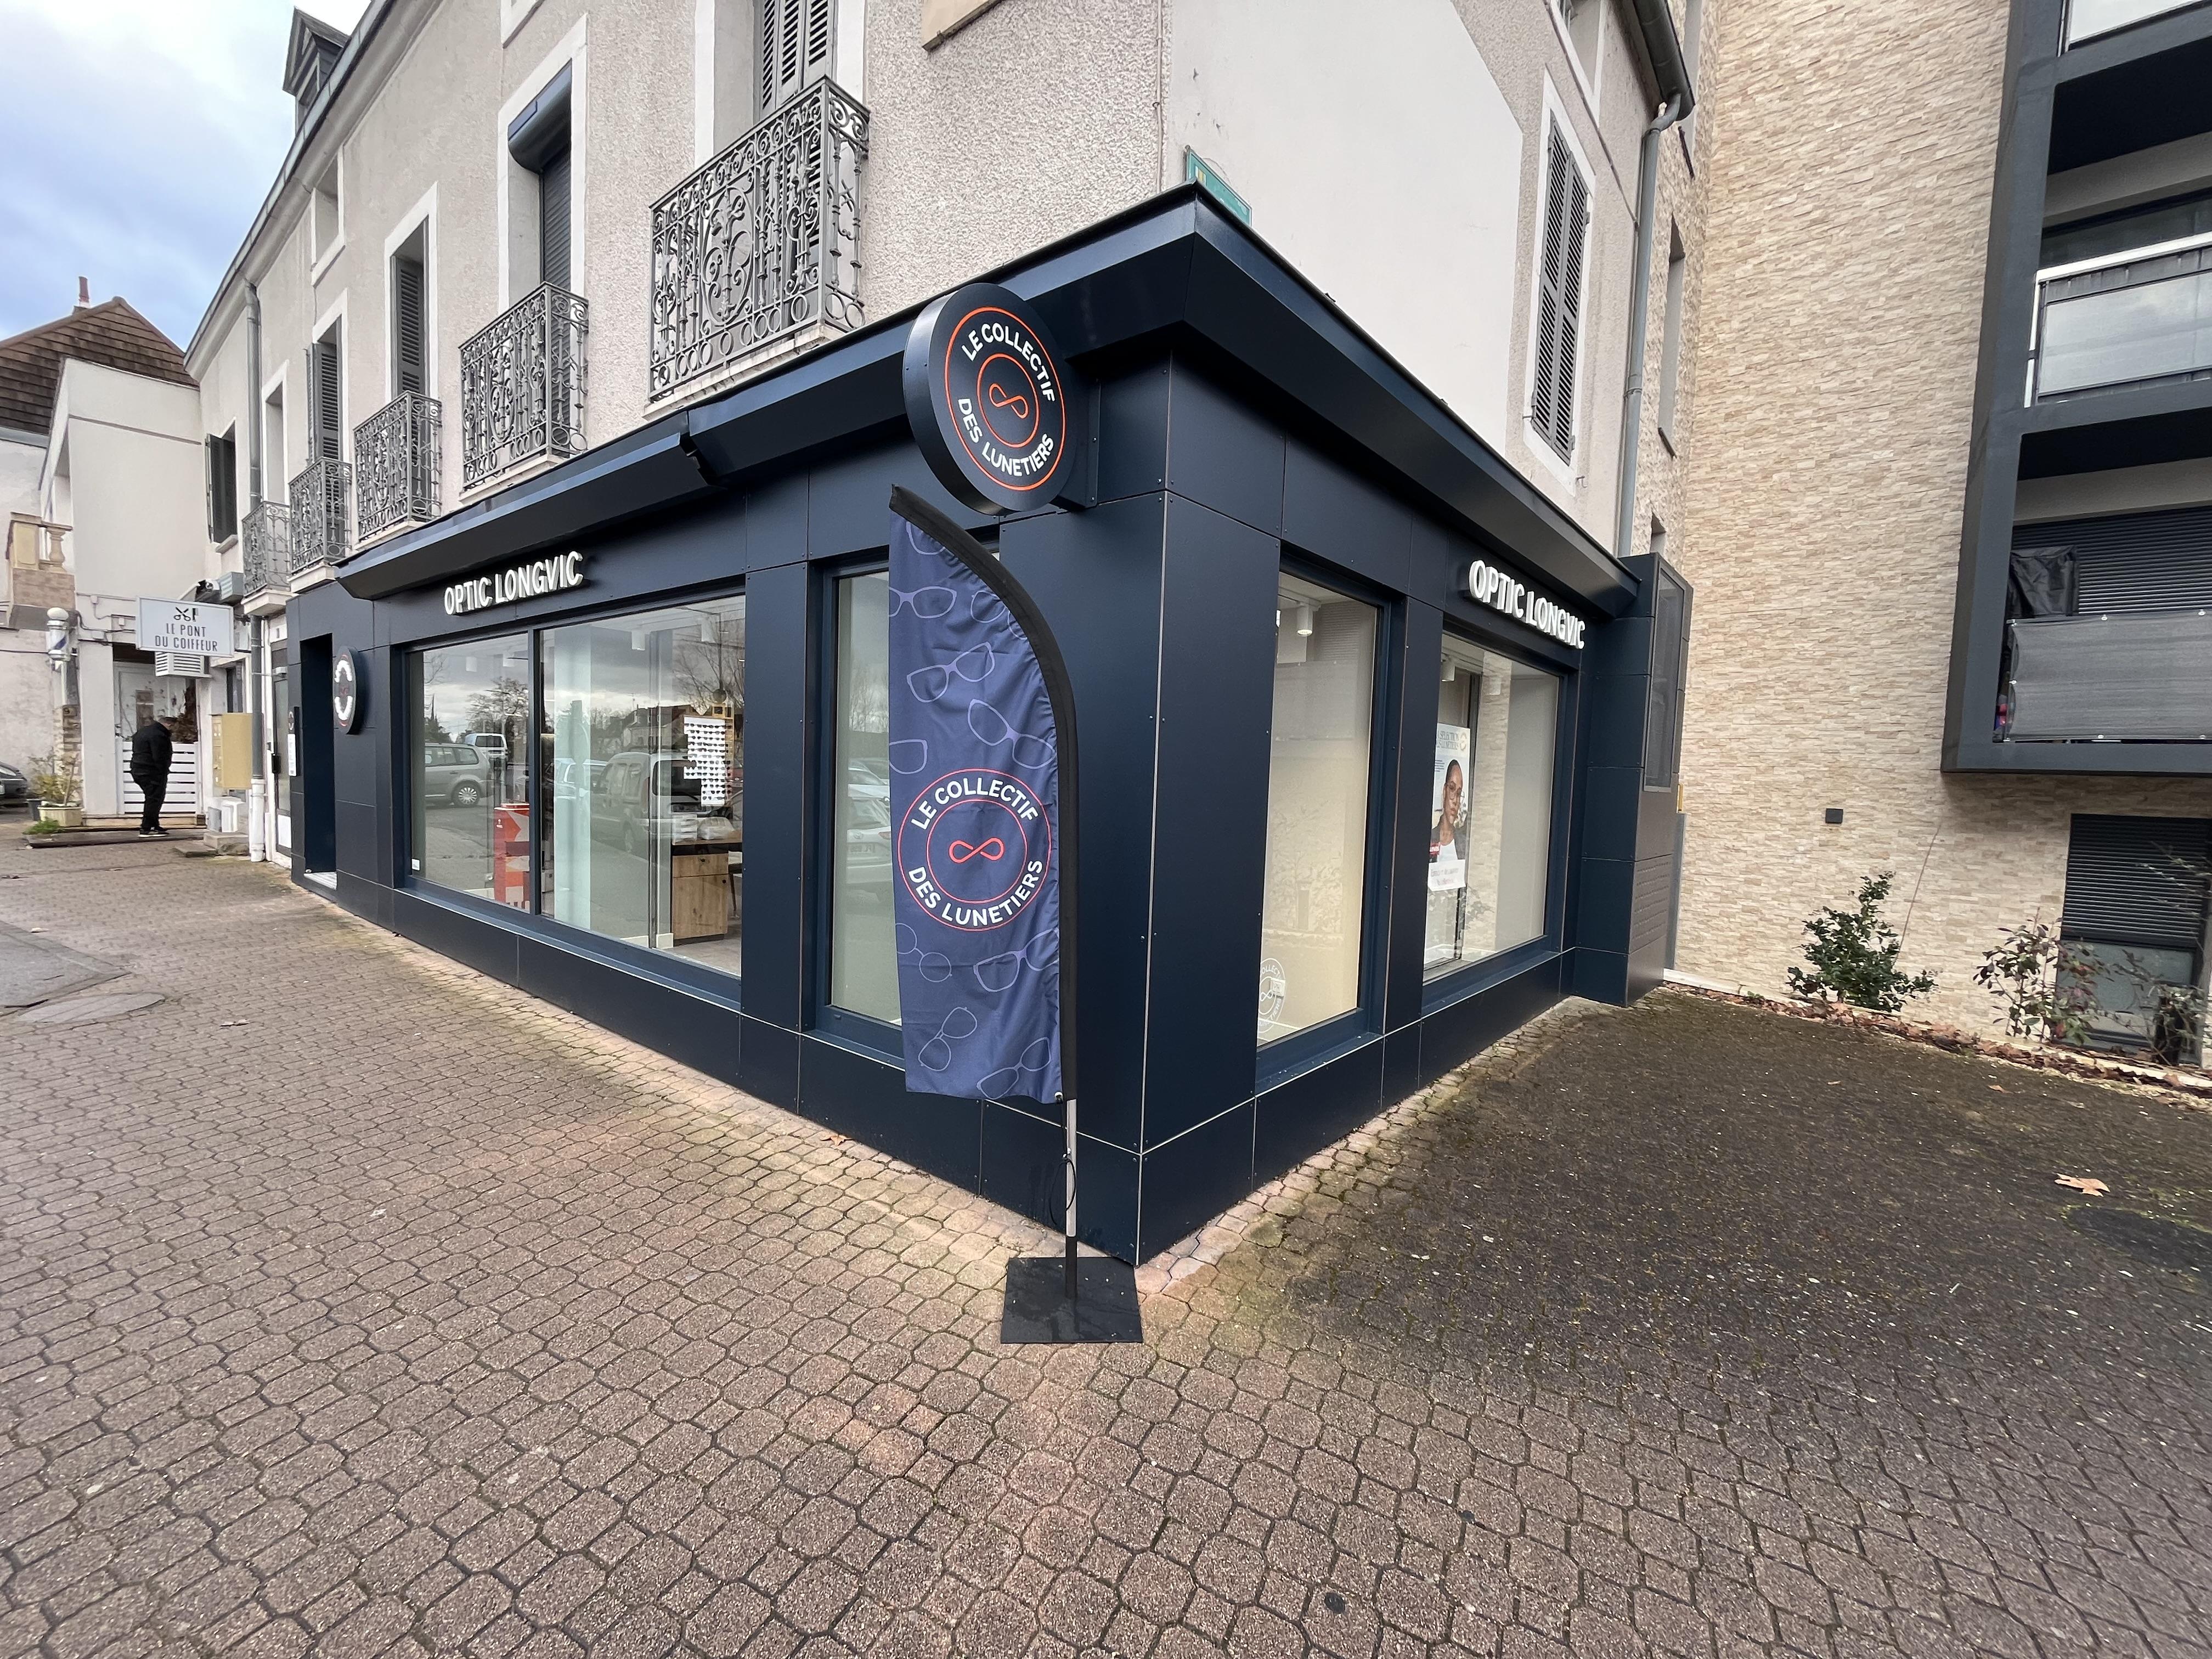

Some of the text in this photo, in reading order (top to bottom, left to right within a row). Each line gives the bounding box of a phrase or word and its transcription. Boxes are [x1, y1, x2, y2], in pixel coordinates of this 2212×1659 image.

[962, 323, 1055, 402] LE COLLECTIF
[958, 398, 1054, 477] DES LUNETIERS
[444, 551, 583, 615] OPTIC LONGVIC
[1469, 560, 1585, 649] OPTIC LONGVIC
[155, 635, 217, 651] DU COIFFEUR
[166, 623, 206, 637] LE PONT
[911, 777, 1039, 830] LE COLLECTIF
[909, 860, 1043, 927] DES LUNETIERS
